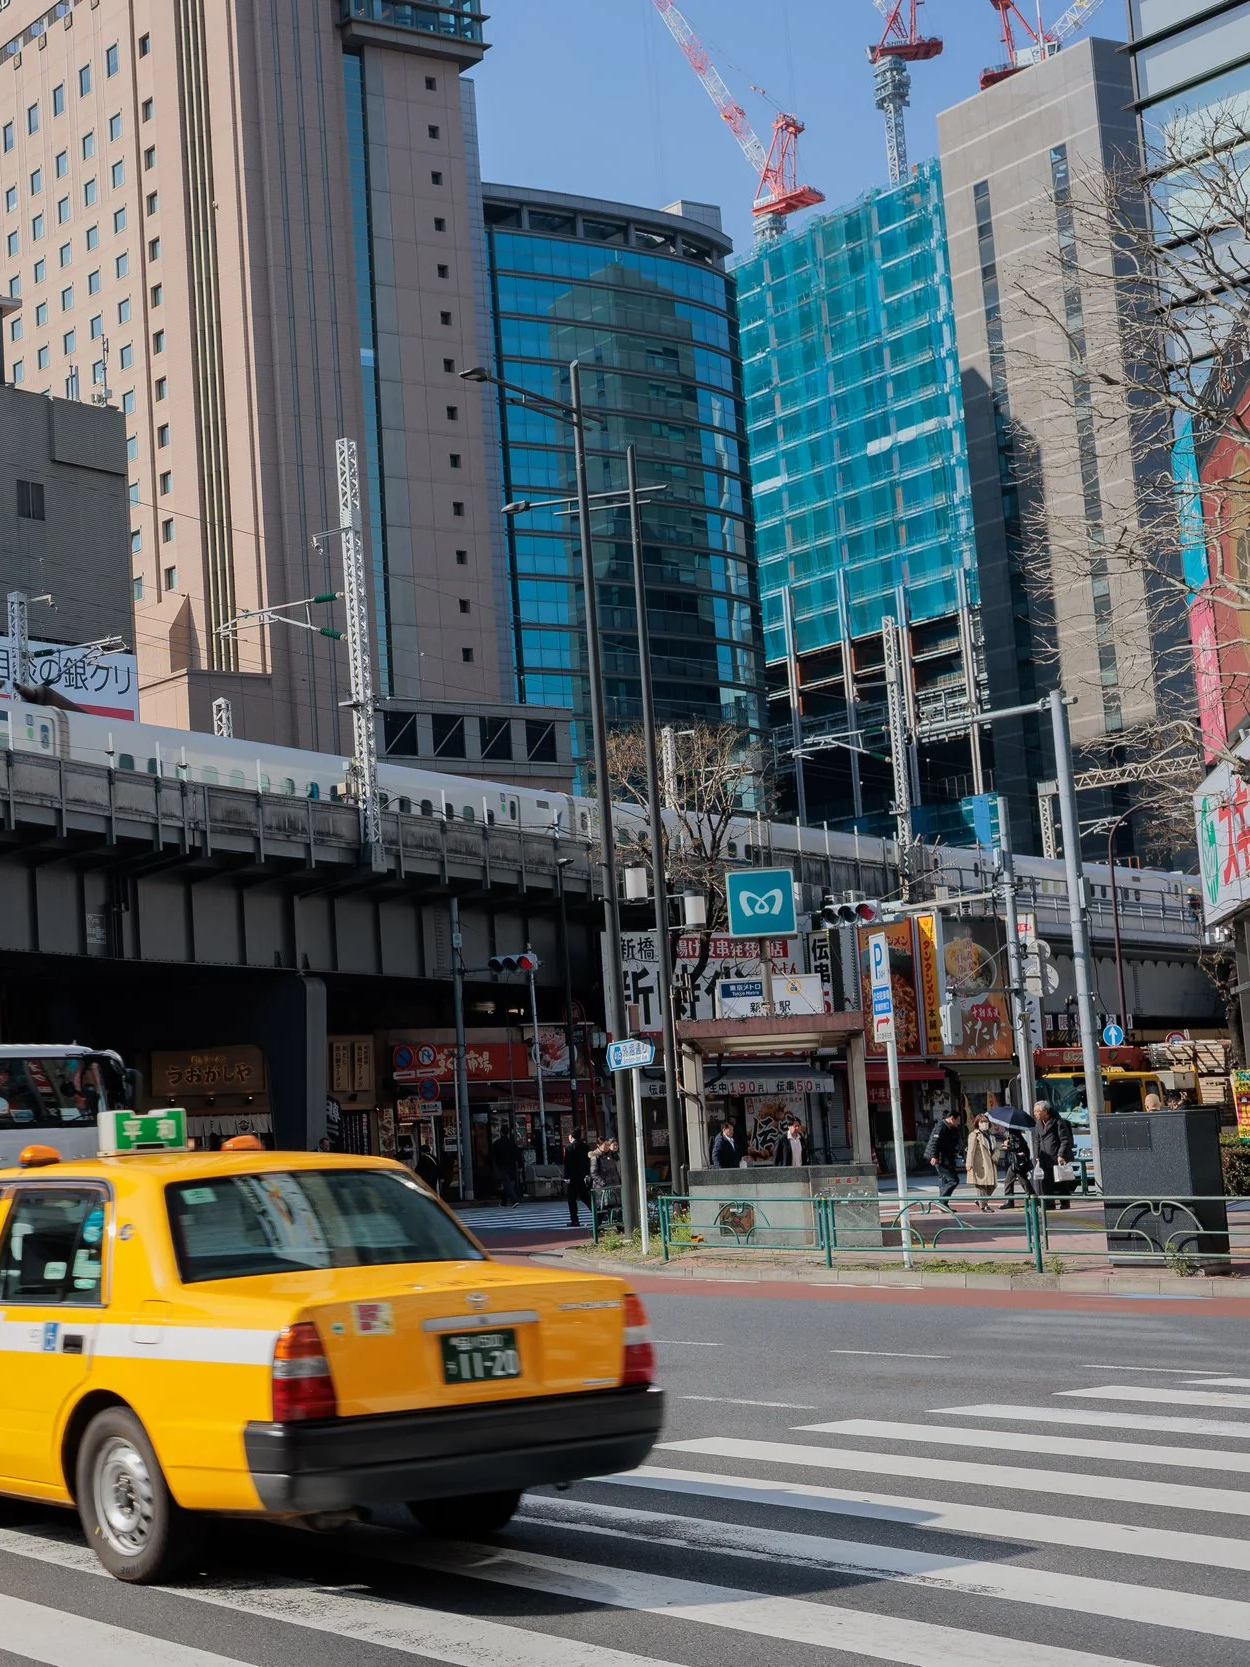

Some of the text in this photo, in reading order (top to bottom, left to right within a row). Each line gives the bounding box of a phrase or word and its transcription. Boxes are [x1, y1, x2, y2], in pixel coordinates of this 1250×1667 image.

[873, 943, 883, 980] P
[730, 983, 761, 992] 東京メトロ
[750, 1000, 791, 1013] 新駅
[436, 1047, 493, 1076] まぐ市場
[166, 1063, 252, 1085] うおがしや
[122, 1119, 177, 1140] 平和
[458, 1349, 521, 1379] 11-20
